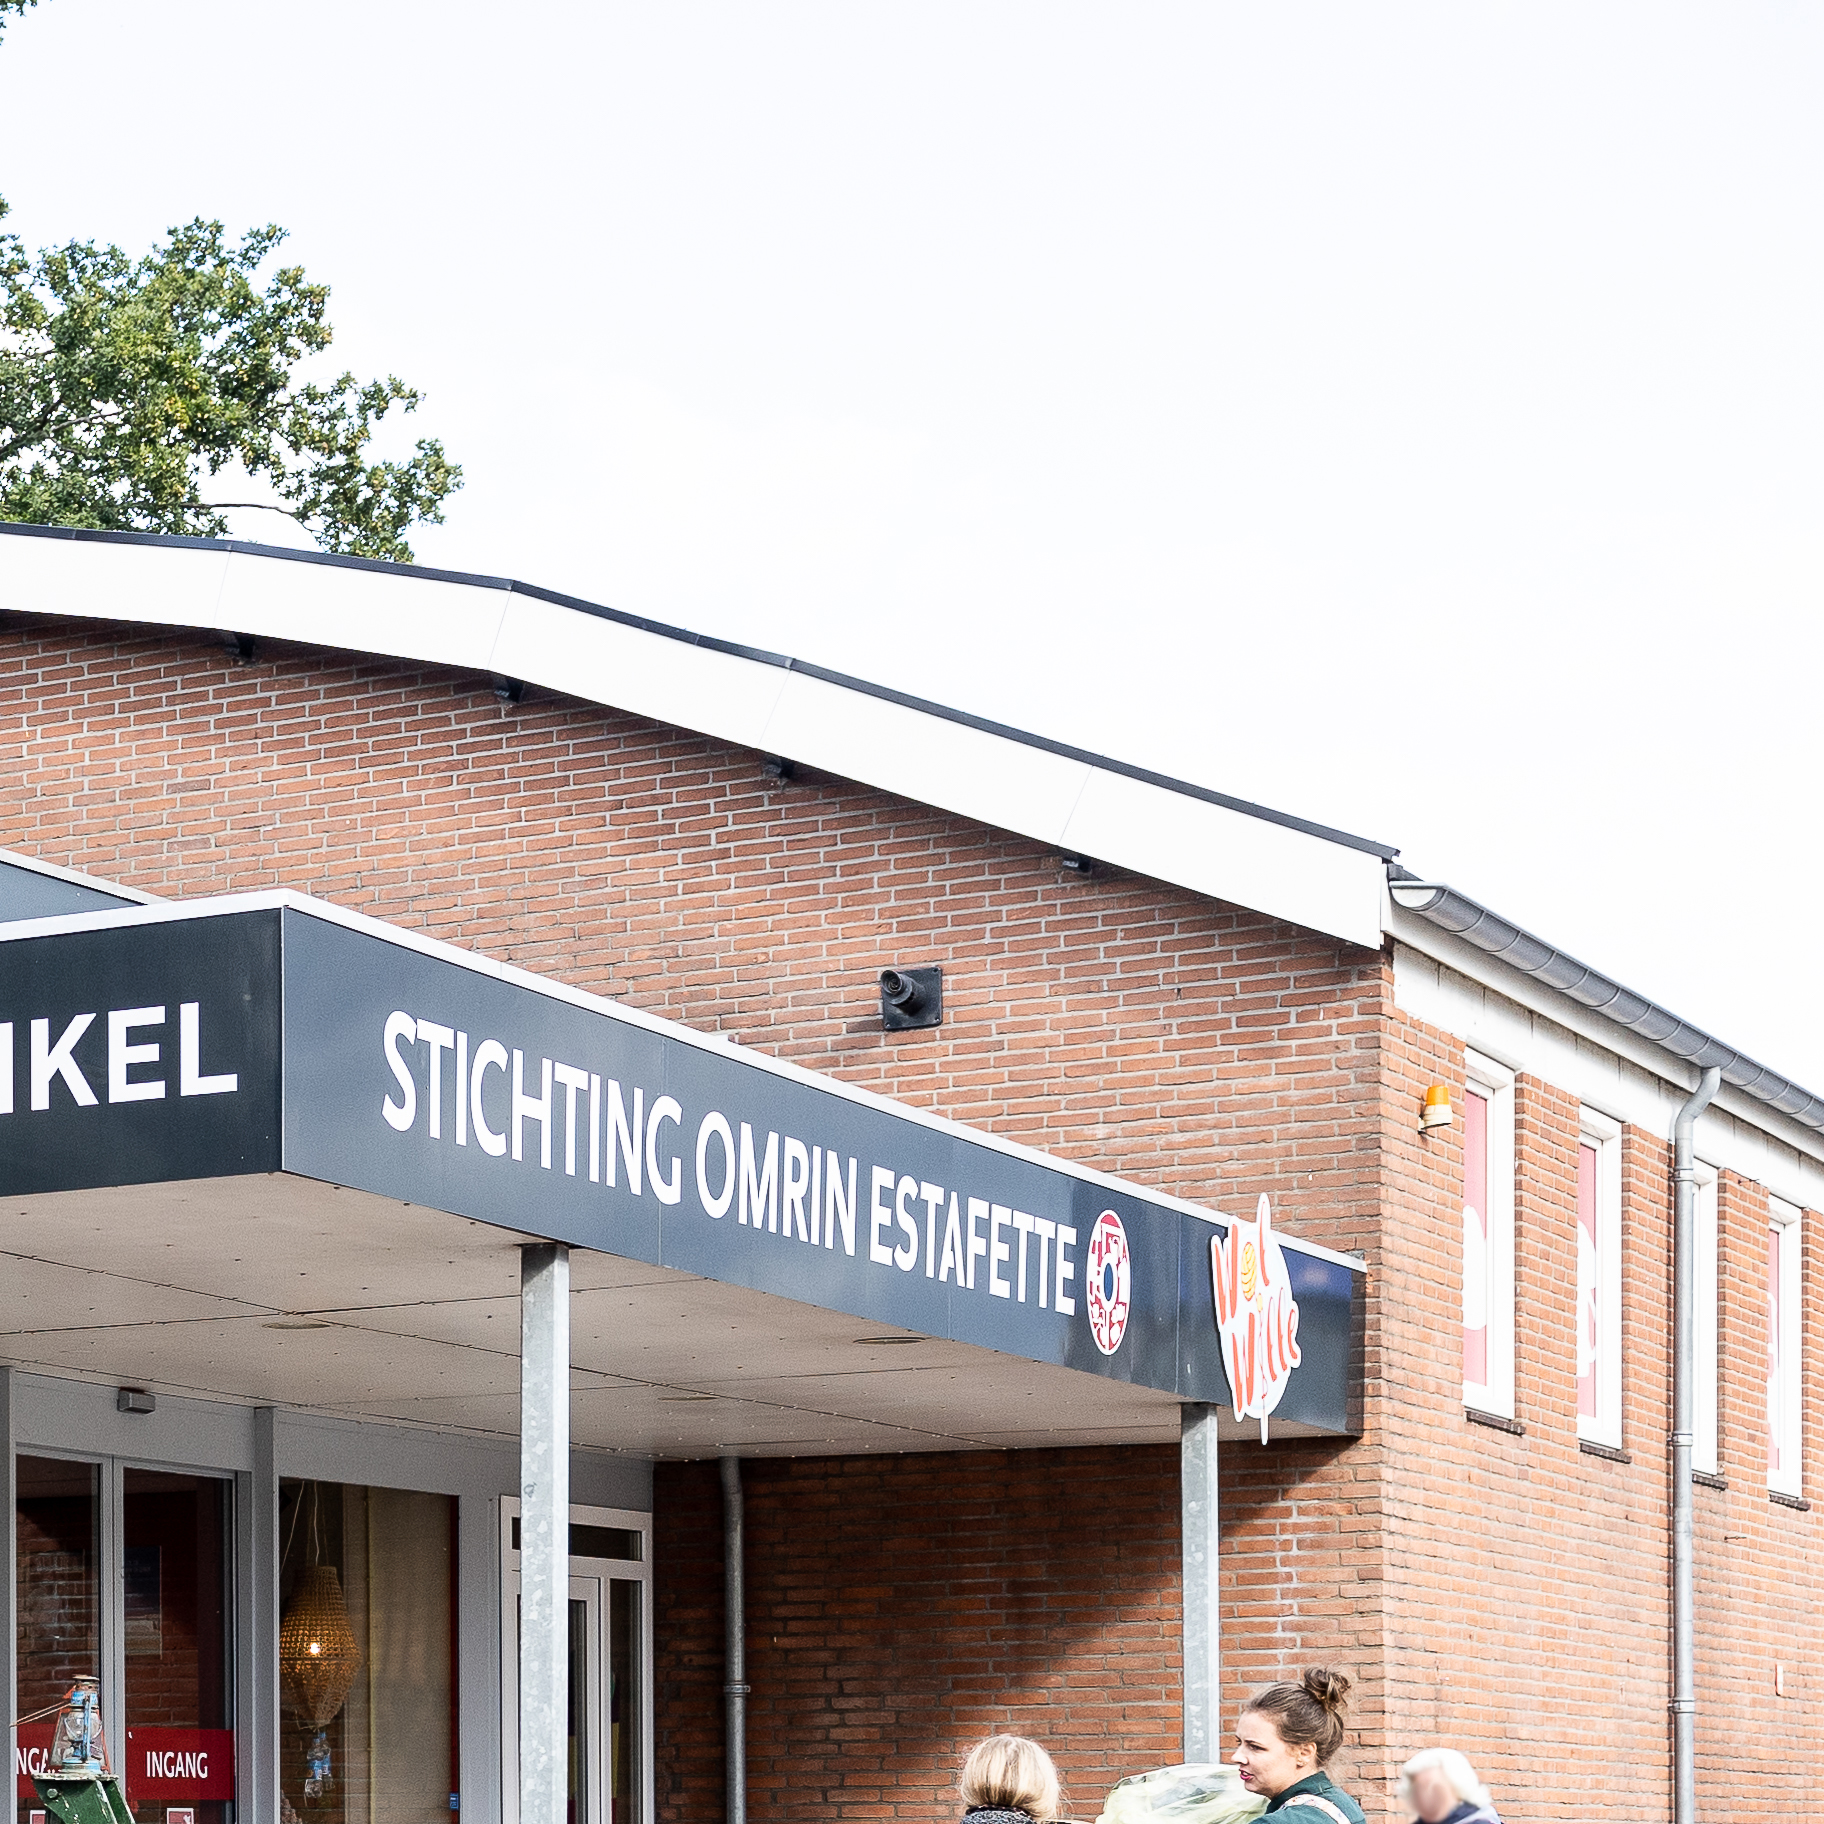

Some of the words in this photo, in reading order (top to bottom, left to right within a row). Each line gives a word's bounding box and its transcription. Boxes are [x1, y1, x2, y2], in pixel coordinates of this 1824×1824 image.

[381, 1009, 683, 1207] STICHTING
[694, 1110, 857, 1257] OMRIN
[868, 1165, 1078, 1318] ESTAFETTE
[146, 1751, 209, 1779] INGANG
